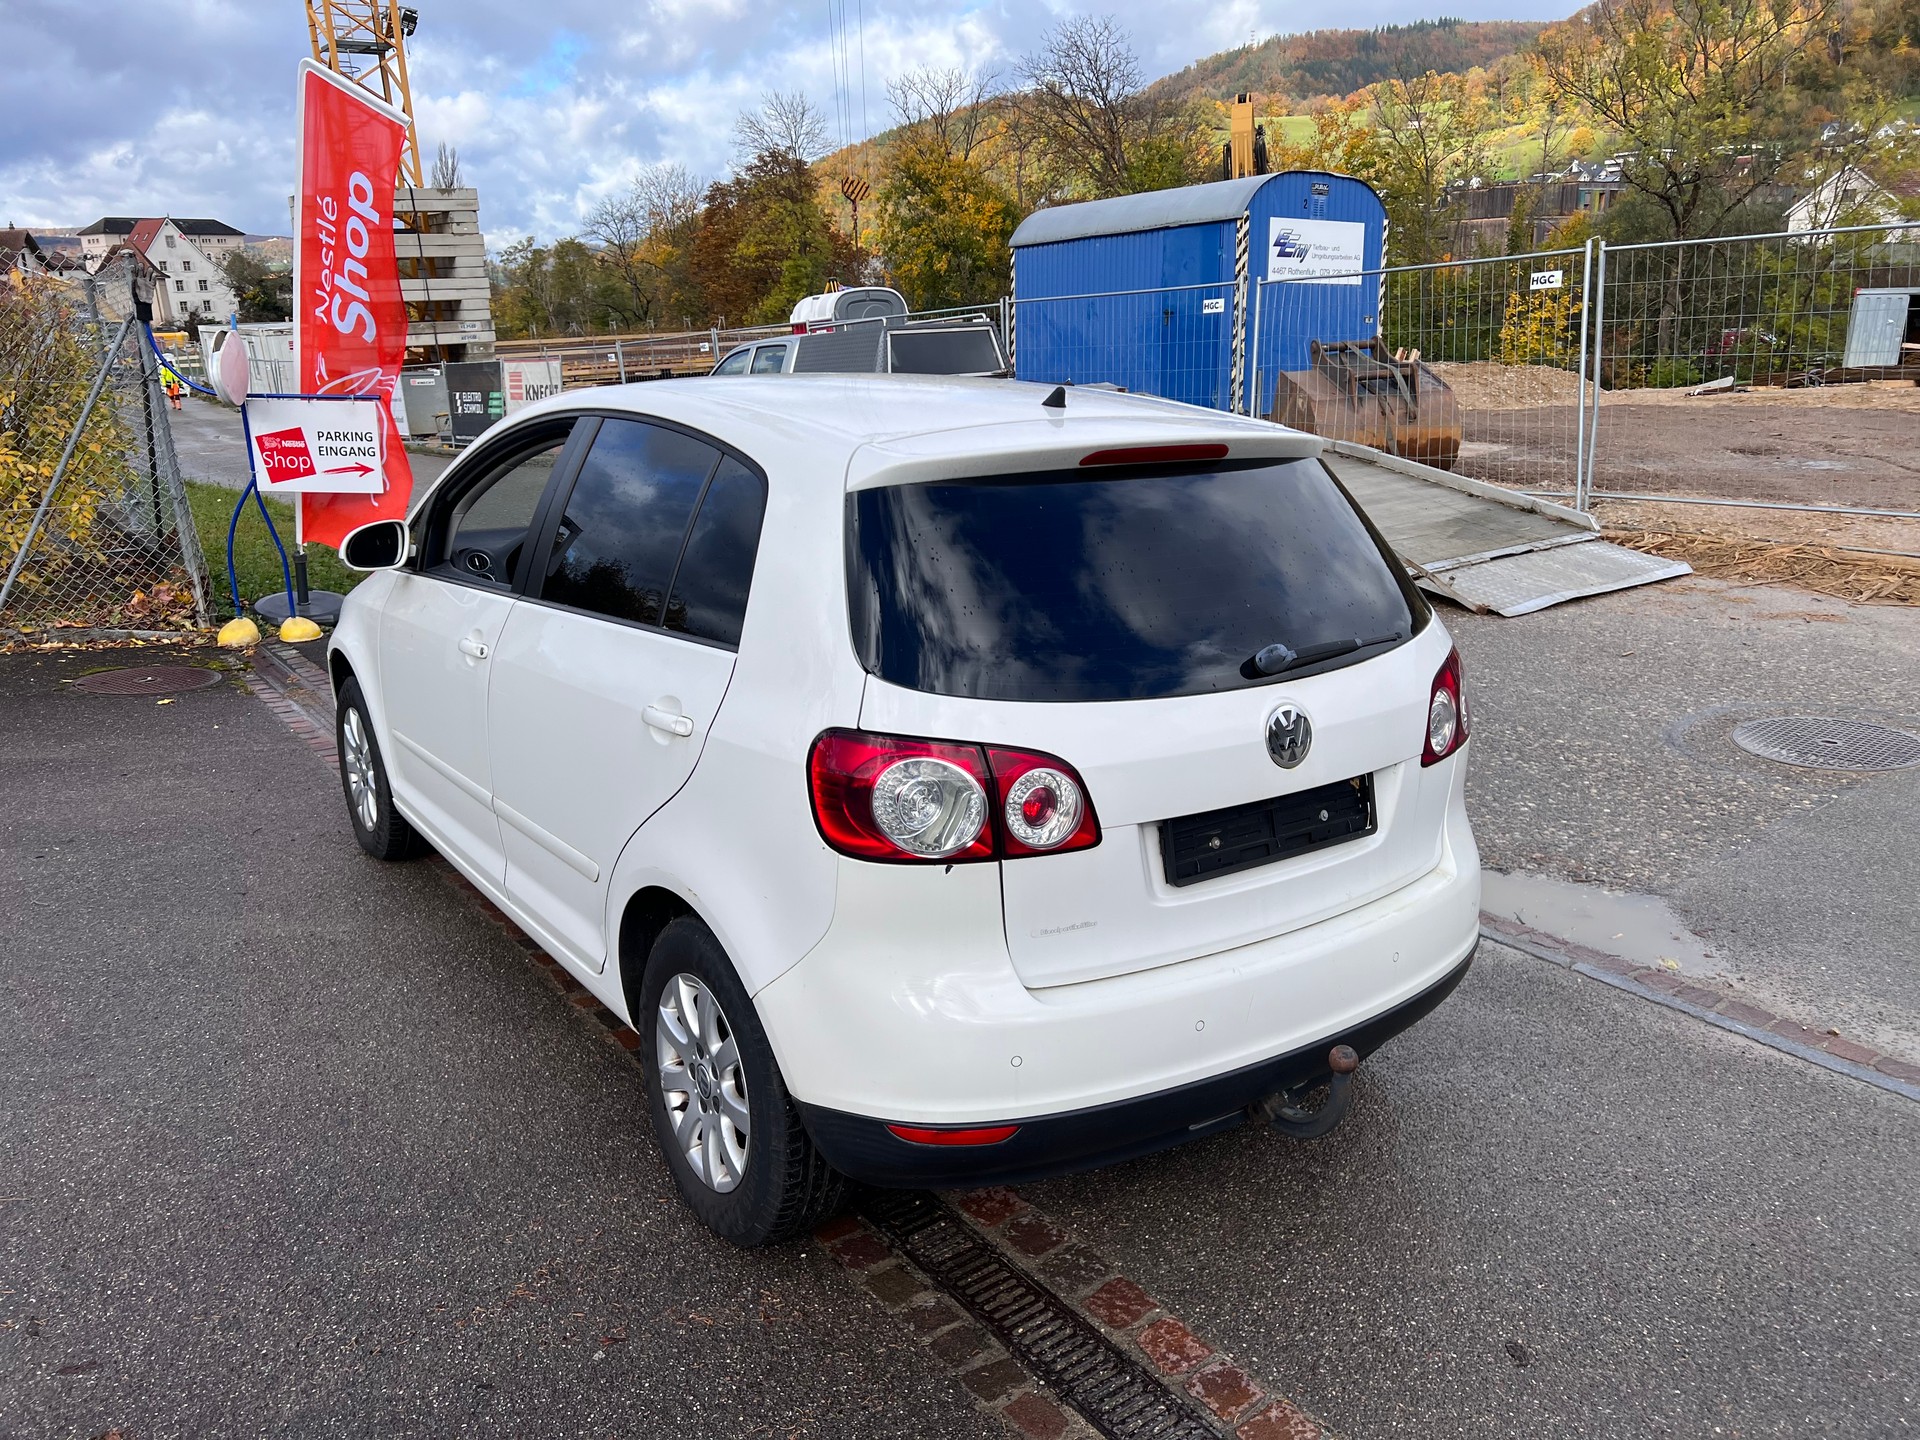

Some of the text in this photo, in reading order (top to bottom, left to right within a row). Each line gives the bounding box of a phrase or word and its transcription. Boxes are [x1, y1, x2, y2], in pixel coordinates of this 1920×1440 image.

[1303, 199, 1308, 209] 2
[315, 195, 337, 324] Nestlé
[331, 171, 380, 344] Shop
[1531, 274, 1555, 286] HGC
[1203, 302, 1219, 310] HGC
[525, 384, 559, 401] KNECHT
[317, 431, 374, 442] PARKING
[318, 446, 376, 457] EINGANG
[262, 451, 312, 473] Shop
